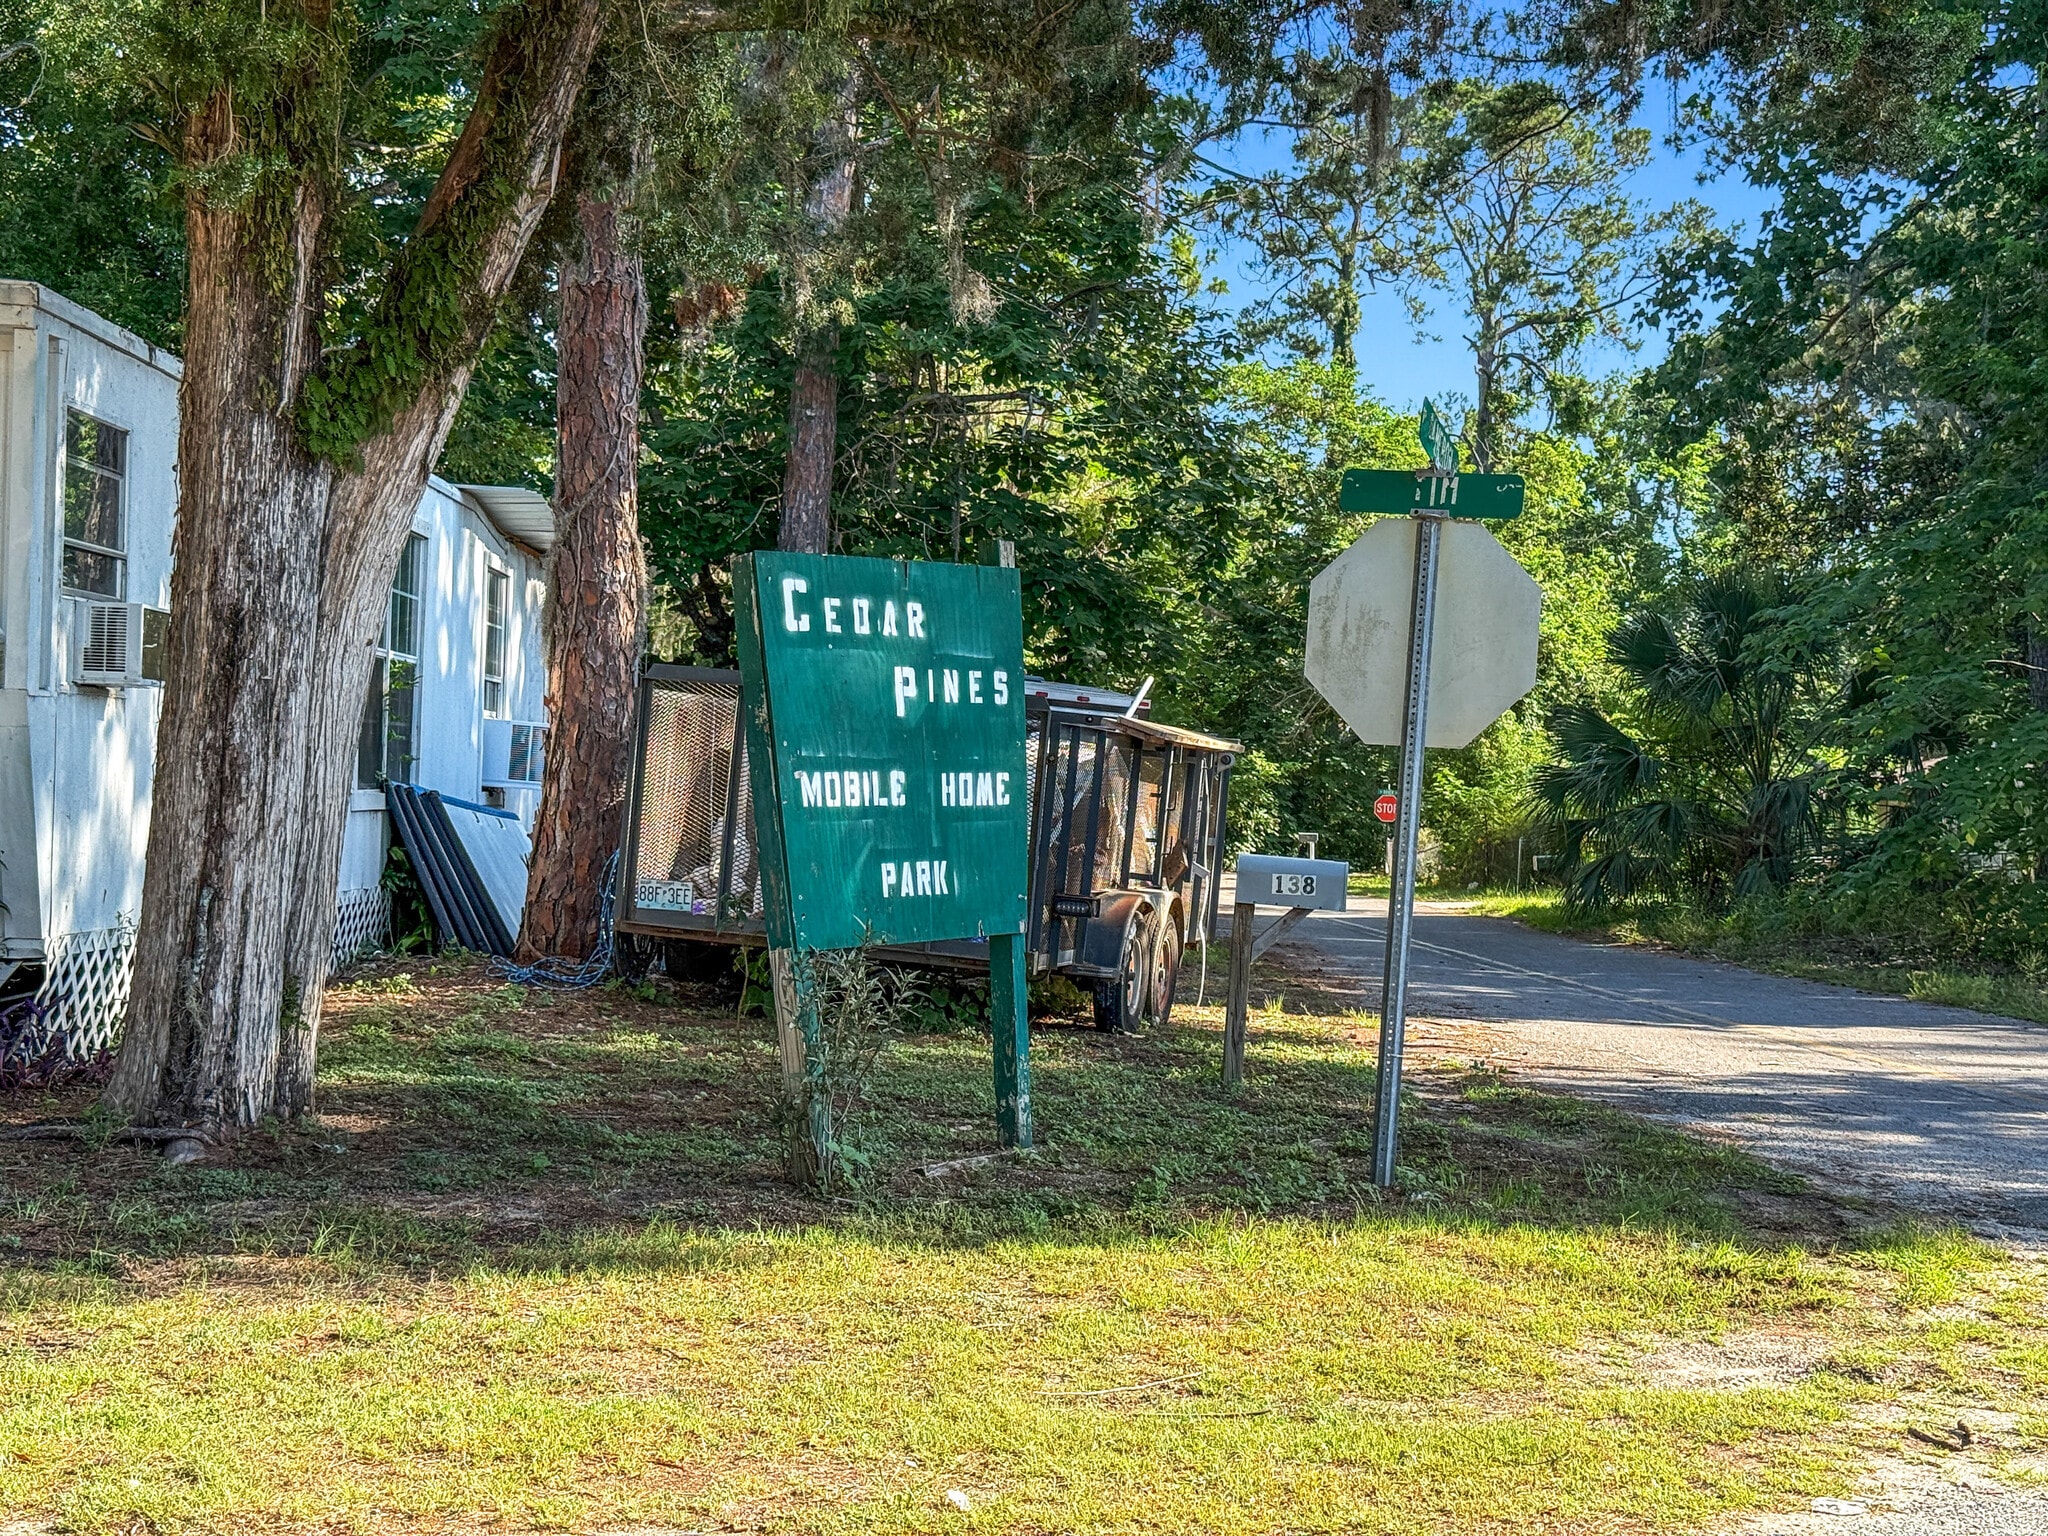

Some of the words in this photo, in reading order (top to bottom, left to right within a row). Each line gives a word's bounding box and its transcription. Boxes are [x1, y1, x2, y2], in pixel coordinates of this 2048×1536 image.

[782, 578, 925, 638] CEDAR
[893, 665, 1009, 717] PINES
[795, 770, 906, 808] MOBILE
[941, 771, 1010, 808] HOME
[639, 885, 662, 903] 88F
[667, 887, 691, 905] 3EE
[881, 860, 949, 898] PARK
[1275, 875, 1315, 895] 138
